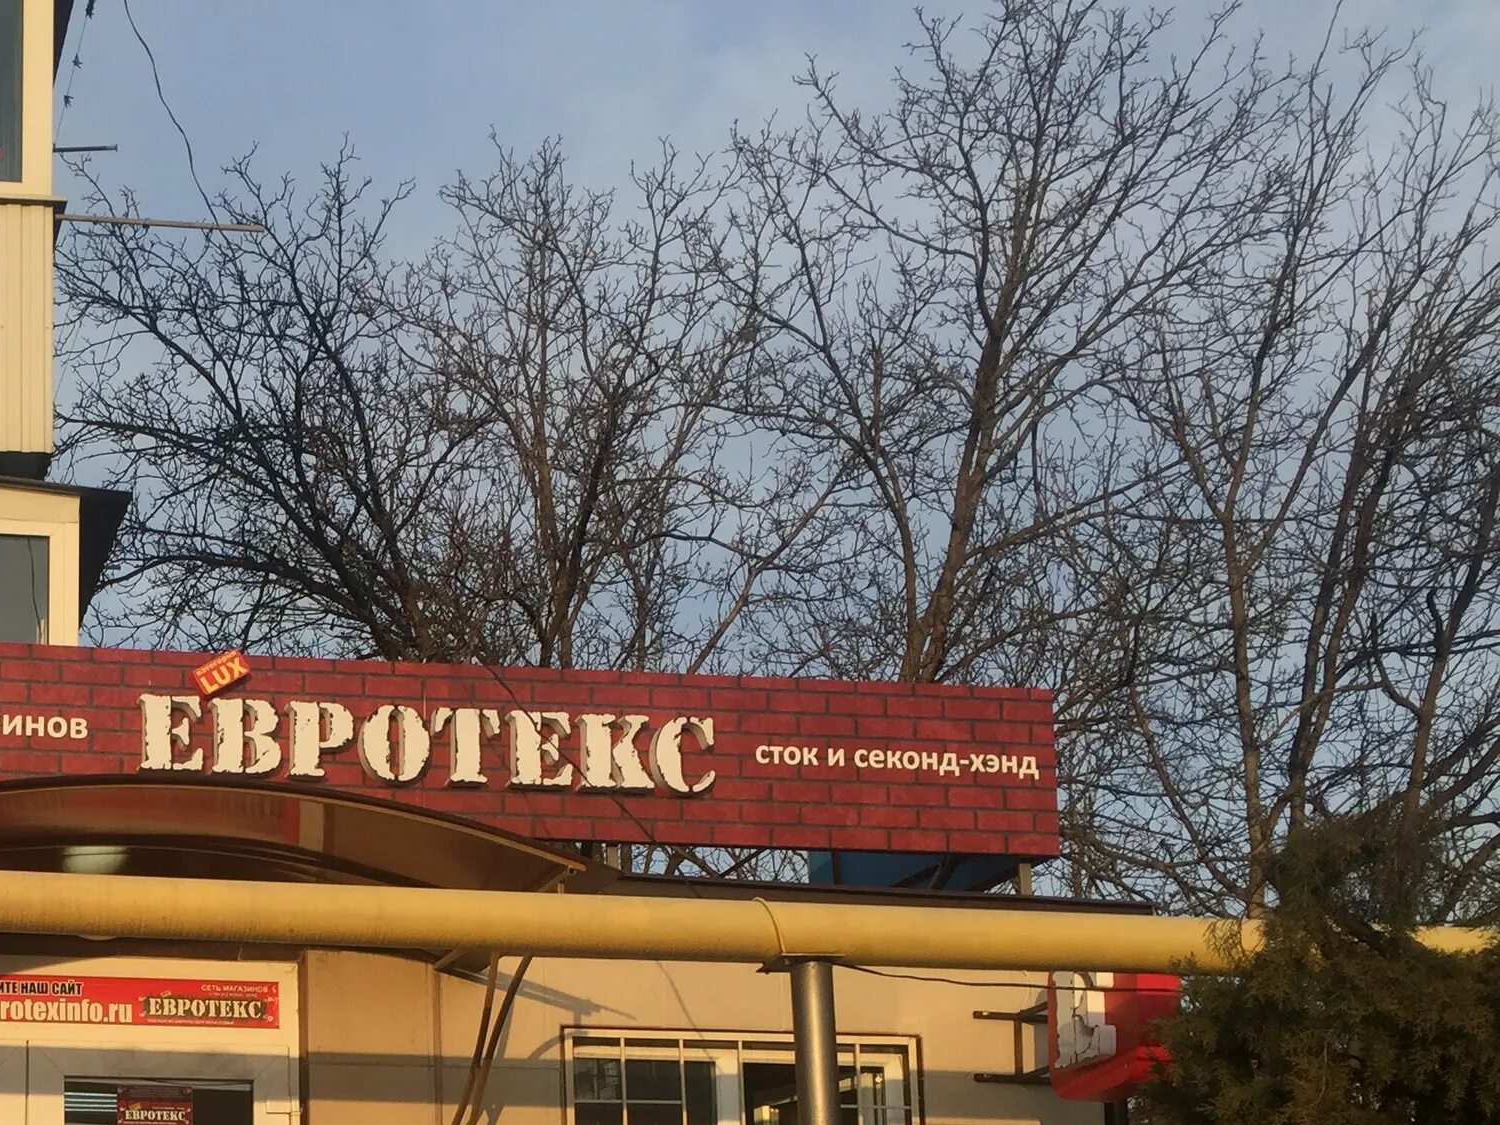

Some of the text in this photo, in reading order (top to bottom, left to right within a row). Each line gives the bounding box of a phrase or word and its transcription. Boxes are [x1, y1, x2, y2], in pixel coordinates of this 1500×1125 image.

[199, 656, 248, 694] LUX
[137, 693, 716, 795] ЕВРОТЕКС
[754, 743, 1039, 780] сток и секонд-хэнд
[21, 980, 50, 996] НАШ
[51, 979, 84, 997] САЙТ
[200, 983, 268, 994] СЕТЬ МАГАЗИНОВ
[148, 997, 262, 1019] ЕВРОТЕКС
[125, 1109, 187, 1121] ЕВРОТЕКС
